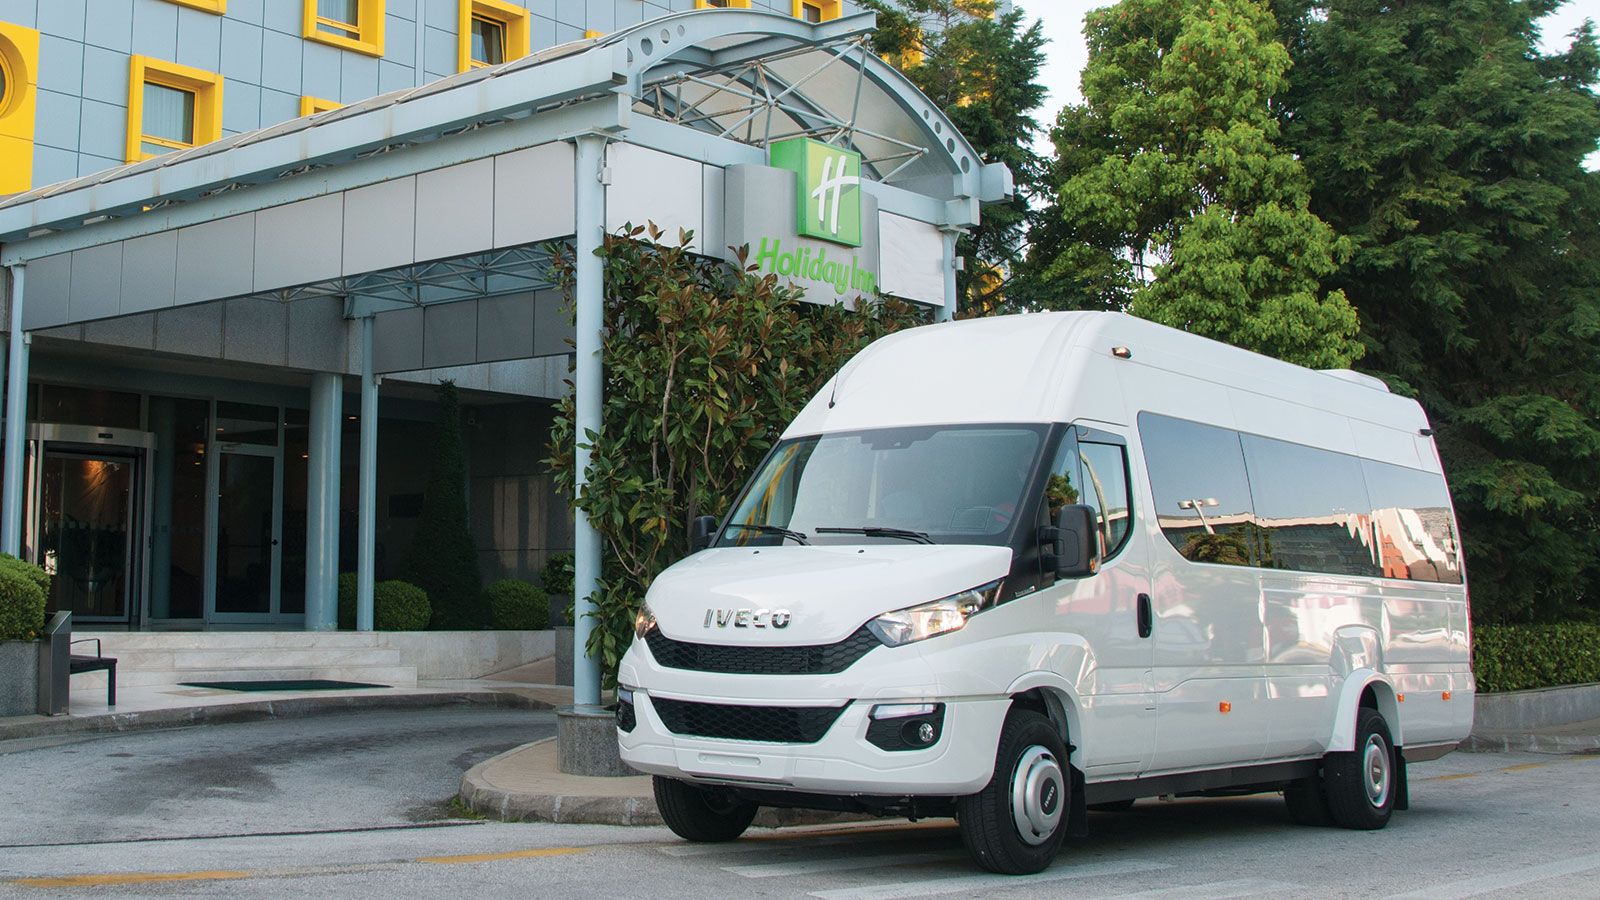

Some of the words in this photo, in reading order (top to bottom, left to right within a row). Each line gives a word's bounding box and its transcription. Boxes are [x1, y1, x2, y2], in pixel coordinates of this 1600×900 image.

[755, 236, 849, 295] Holiday
[851, 255, 875, 294] Inn
[704, 608, 791, 629] IVECO
